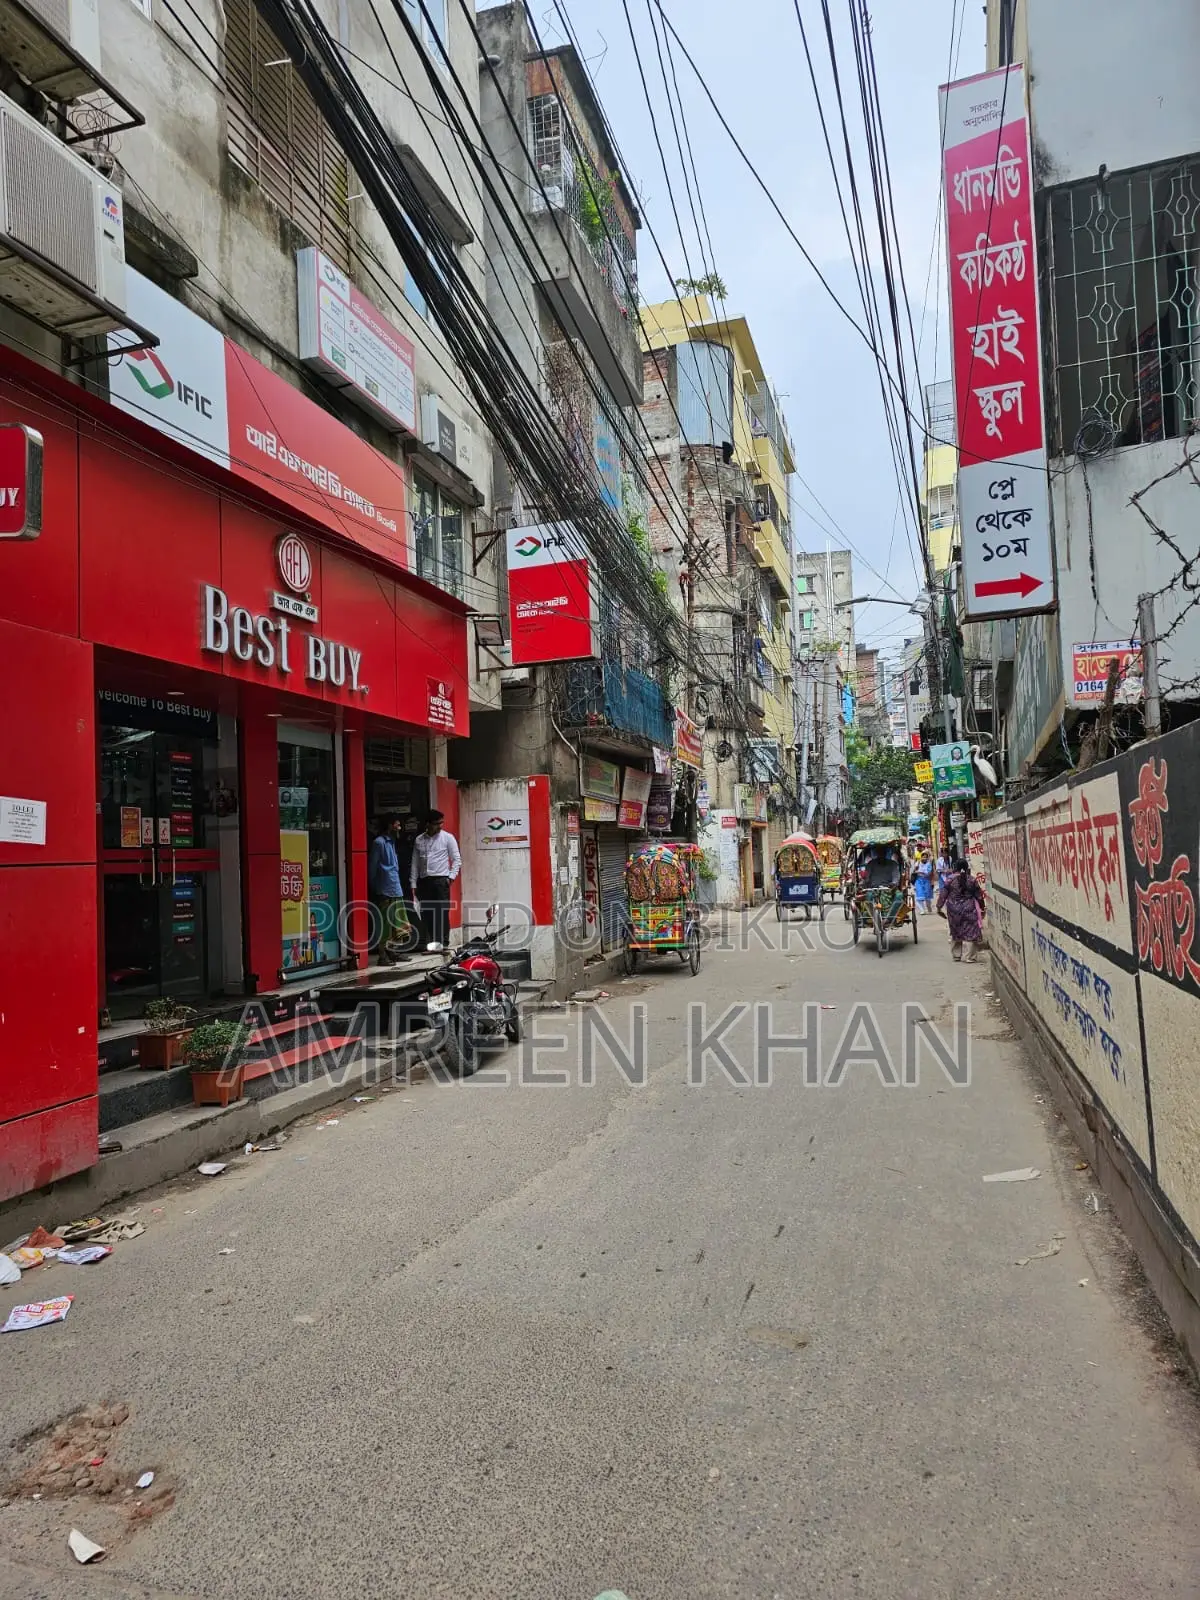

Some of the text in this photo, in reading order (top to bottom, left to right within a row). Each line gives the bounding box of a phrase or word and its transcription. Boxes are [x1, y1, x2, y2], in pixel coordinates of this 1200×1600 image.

[969, 99, 998, 113] সরকার
[966, 304, 1026, 370] হাই
[177, 380, 213, 420] IFIC
[972, 380, 1026, 443] স্কুল
[0, 487, 20, 507] UY
[987, 476, 1017, 500] প্লে
[975, 507, 1034, 534] থেকে
[981, 537, 1031, 563] ১০ম
[203, 583, 361, 691] Best BUY
[506, 818, 523, 828] IFIC
